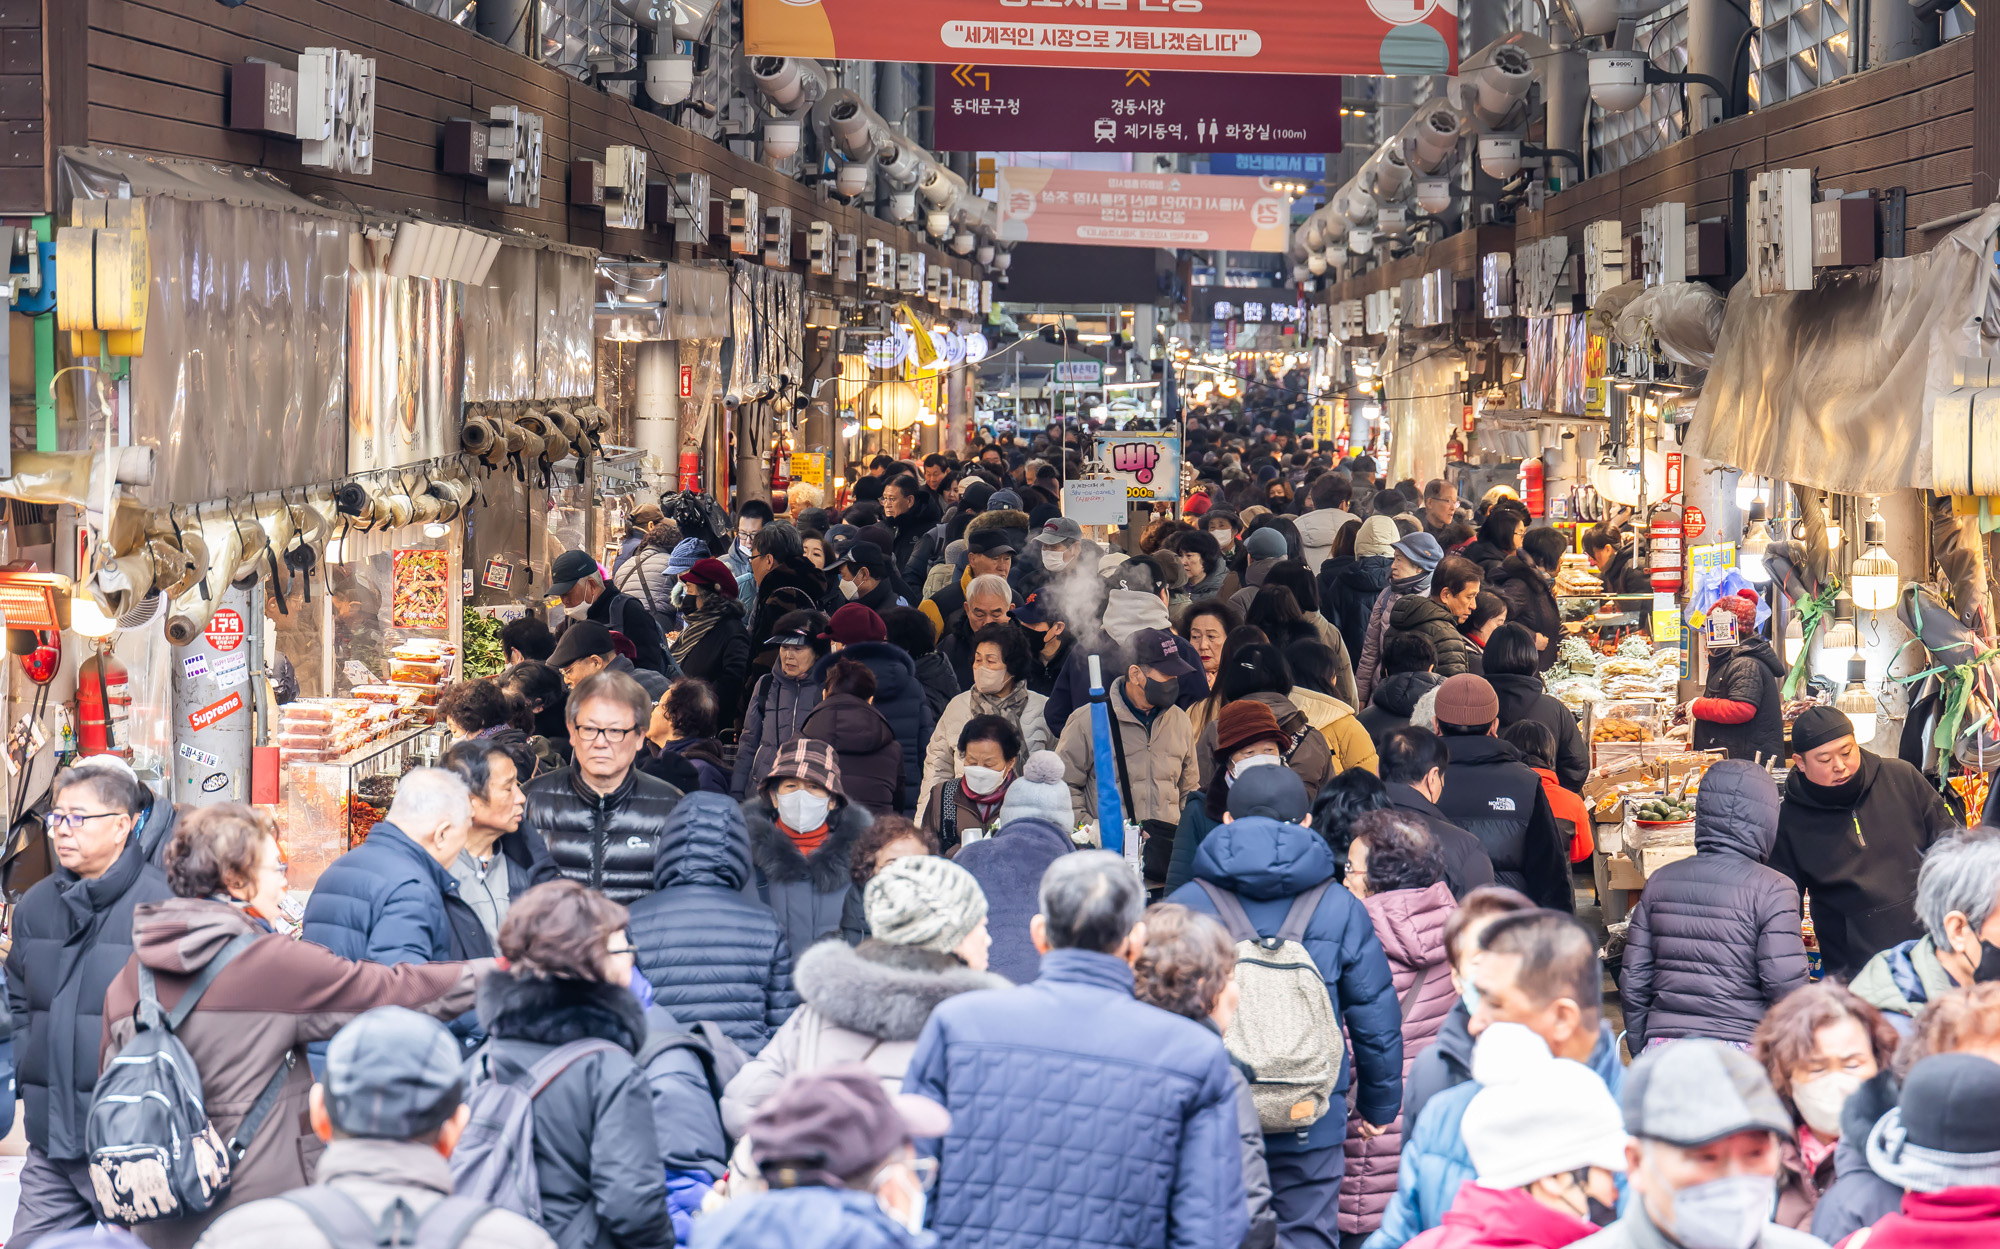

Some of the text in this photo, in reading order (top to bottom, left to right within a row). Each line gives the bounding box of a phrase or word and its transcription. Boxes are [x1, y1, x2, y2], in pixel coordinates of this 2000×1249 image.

[955, 25, 1248, 52] "세계적인 시장으로 거듭나겠습니다"
[950, 98, 1020, 115] 동대문구청
[1111, 98, 1166, 116] 경동시장
[1124, 123, 1307, 141] 제기동역, 화장실 (100m)
[1112, 441, 1161, 485] 빵
[1683, 512, 1702, 524] 1구역
[209, 617, 239, 632] 1구역
[184, 655, 204, 666] SUPER
[187, 667, 208, 678] SEOUL
[192, 697, 239, 727] Supreme
